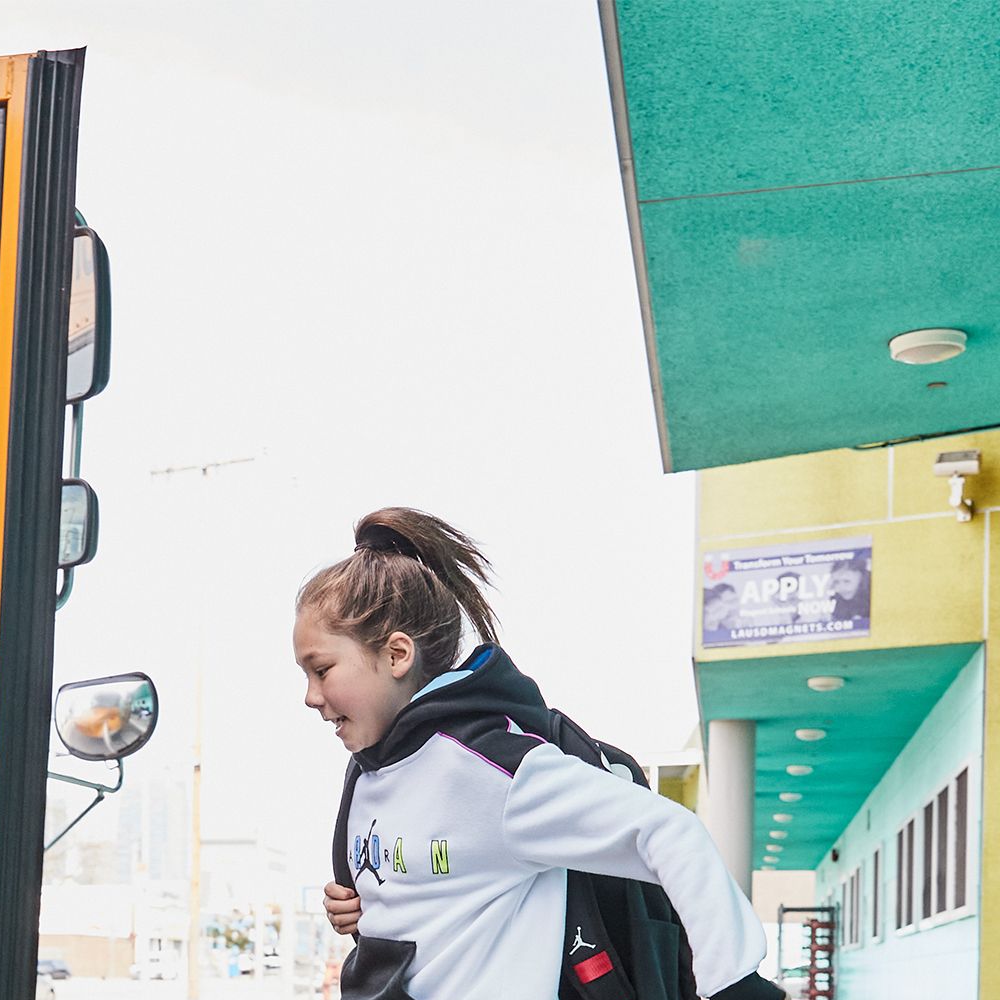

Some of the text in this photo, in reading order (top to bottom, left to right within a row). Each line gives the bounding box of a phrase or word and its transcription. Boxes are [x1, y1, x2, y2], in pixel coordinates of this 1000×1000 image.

[732, 551, 855, 571] Transform Your Tomorrow
[797, 599, 838, 616] NOW
[730, 620, 854, 640] LAUSDMAGNETS.COM
